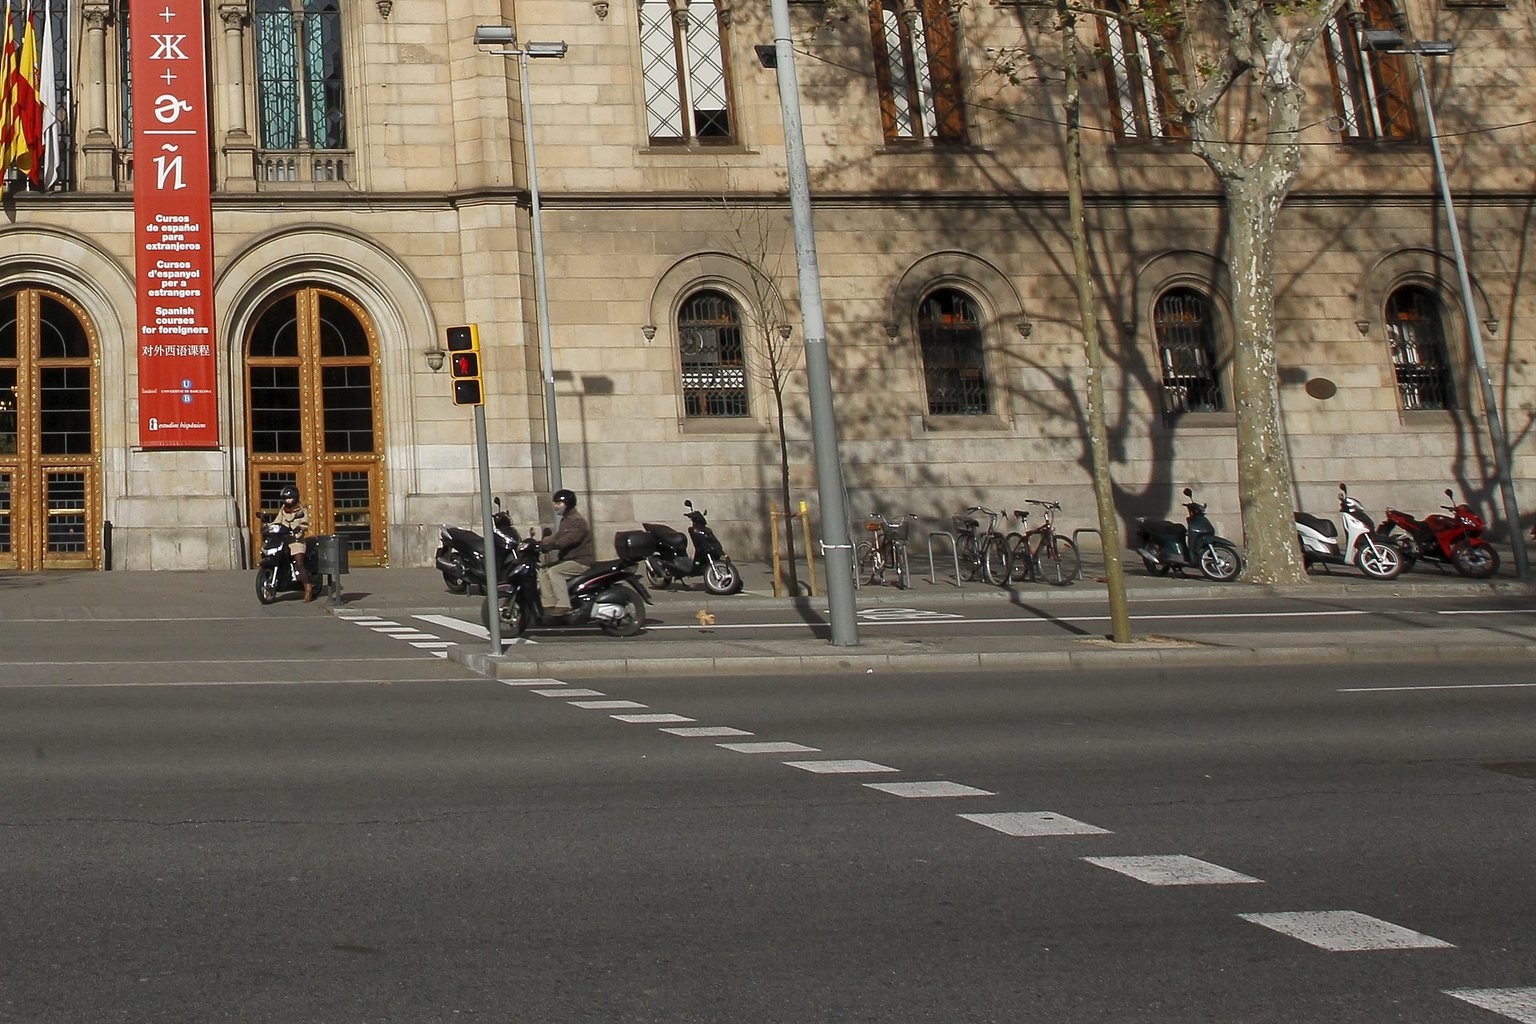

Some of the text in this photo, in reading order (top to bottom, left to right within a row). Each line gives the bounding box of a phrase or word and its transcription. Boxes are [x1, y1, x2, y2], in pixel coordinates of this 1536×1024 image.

[155, 214, 190, 223] Cursos
[146, 223, 199, 233] de español
[161, 234, 184, 242] para
[145, 241, 201, 252] extranjeros
[156, 260, 191, 269] Cursos
[147, 269, 200, 279] d'espanyol
[161, 280, 178, 288] per
[147, 288, 201, 298] estrangers
[155, 306, 195, 317] Spanish
[155, 317, 195, 325] courses
[141, 325, 209, 336] for foreigners
